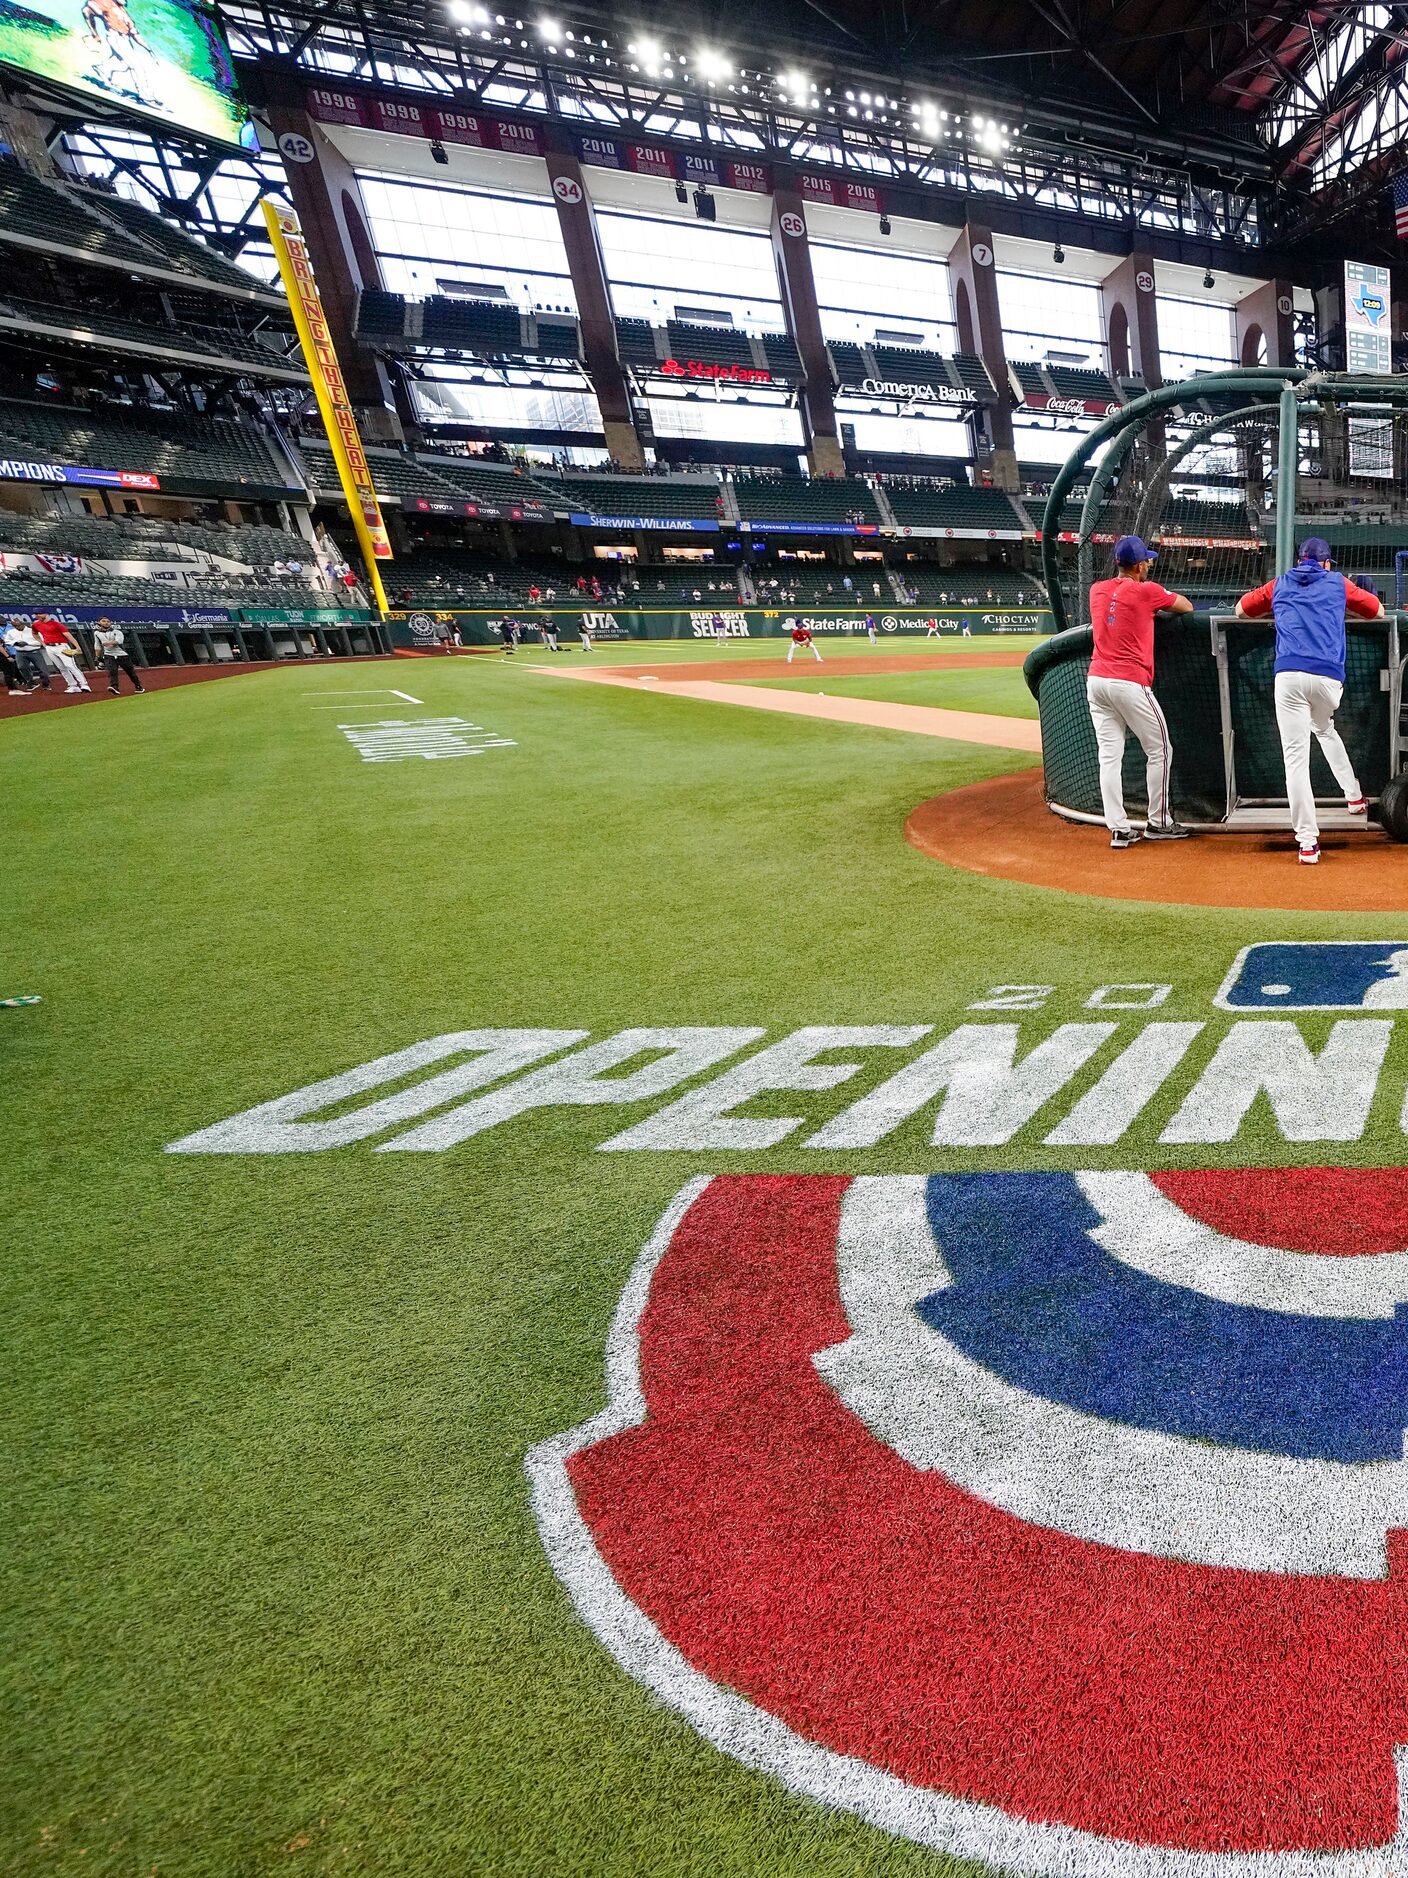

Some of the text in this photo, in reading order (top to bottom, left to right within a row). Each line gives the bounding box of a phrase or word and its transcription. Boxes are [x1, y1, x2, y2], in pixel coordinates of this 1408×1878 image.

[312, 89, 357, 110] 1996
[378, 101, 422, 121] 1998
[437, 111, 479, 131] 1999
[498, 122, 535, 141] 2010
[284, 138, 311, 157] 42
[581, 137, 616, 155] 2010
[635, 146, 666, 164] 2011
[685, 155, 715, 172] 2011
[733, 163, 765, 181] 2012
[556, 181, 580, 198] 34
[802, 175, 832, 192] 2015
[847, 183, 876, 199] 2016
[783, 218, 802, 232] 26
[978, 248, 987, 262] 7
[1137, 275, 1153, 289] 29
[1280, 299, 1290, 312] 10
[286, 239, 367, 484] BRING THE HEAT
[937, 386, 978, 402] Bank
[1046, 396, 1087, 415] Coca-Cola
[123, 474, 152, 484] DEX
[429, 503, 454, 511] TOYOTA
[478, 507, 500, 515] TOYOTA
[522, 511, 543, 519] TOYOTA
[195, 613, 228, 622] Germania
[435, 613, 453, 621] 334
[583, 613, 619, 629] UTA
[690, 612, 713, 620] BUD
[989, 614, 1039, 624] CHOCTAW
[691, 619, 751, 638] SELZER
[900, 619, 959, 631] Medicl City
